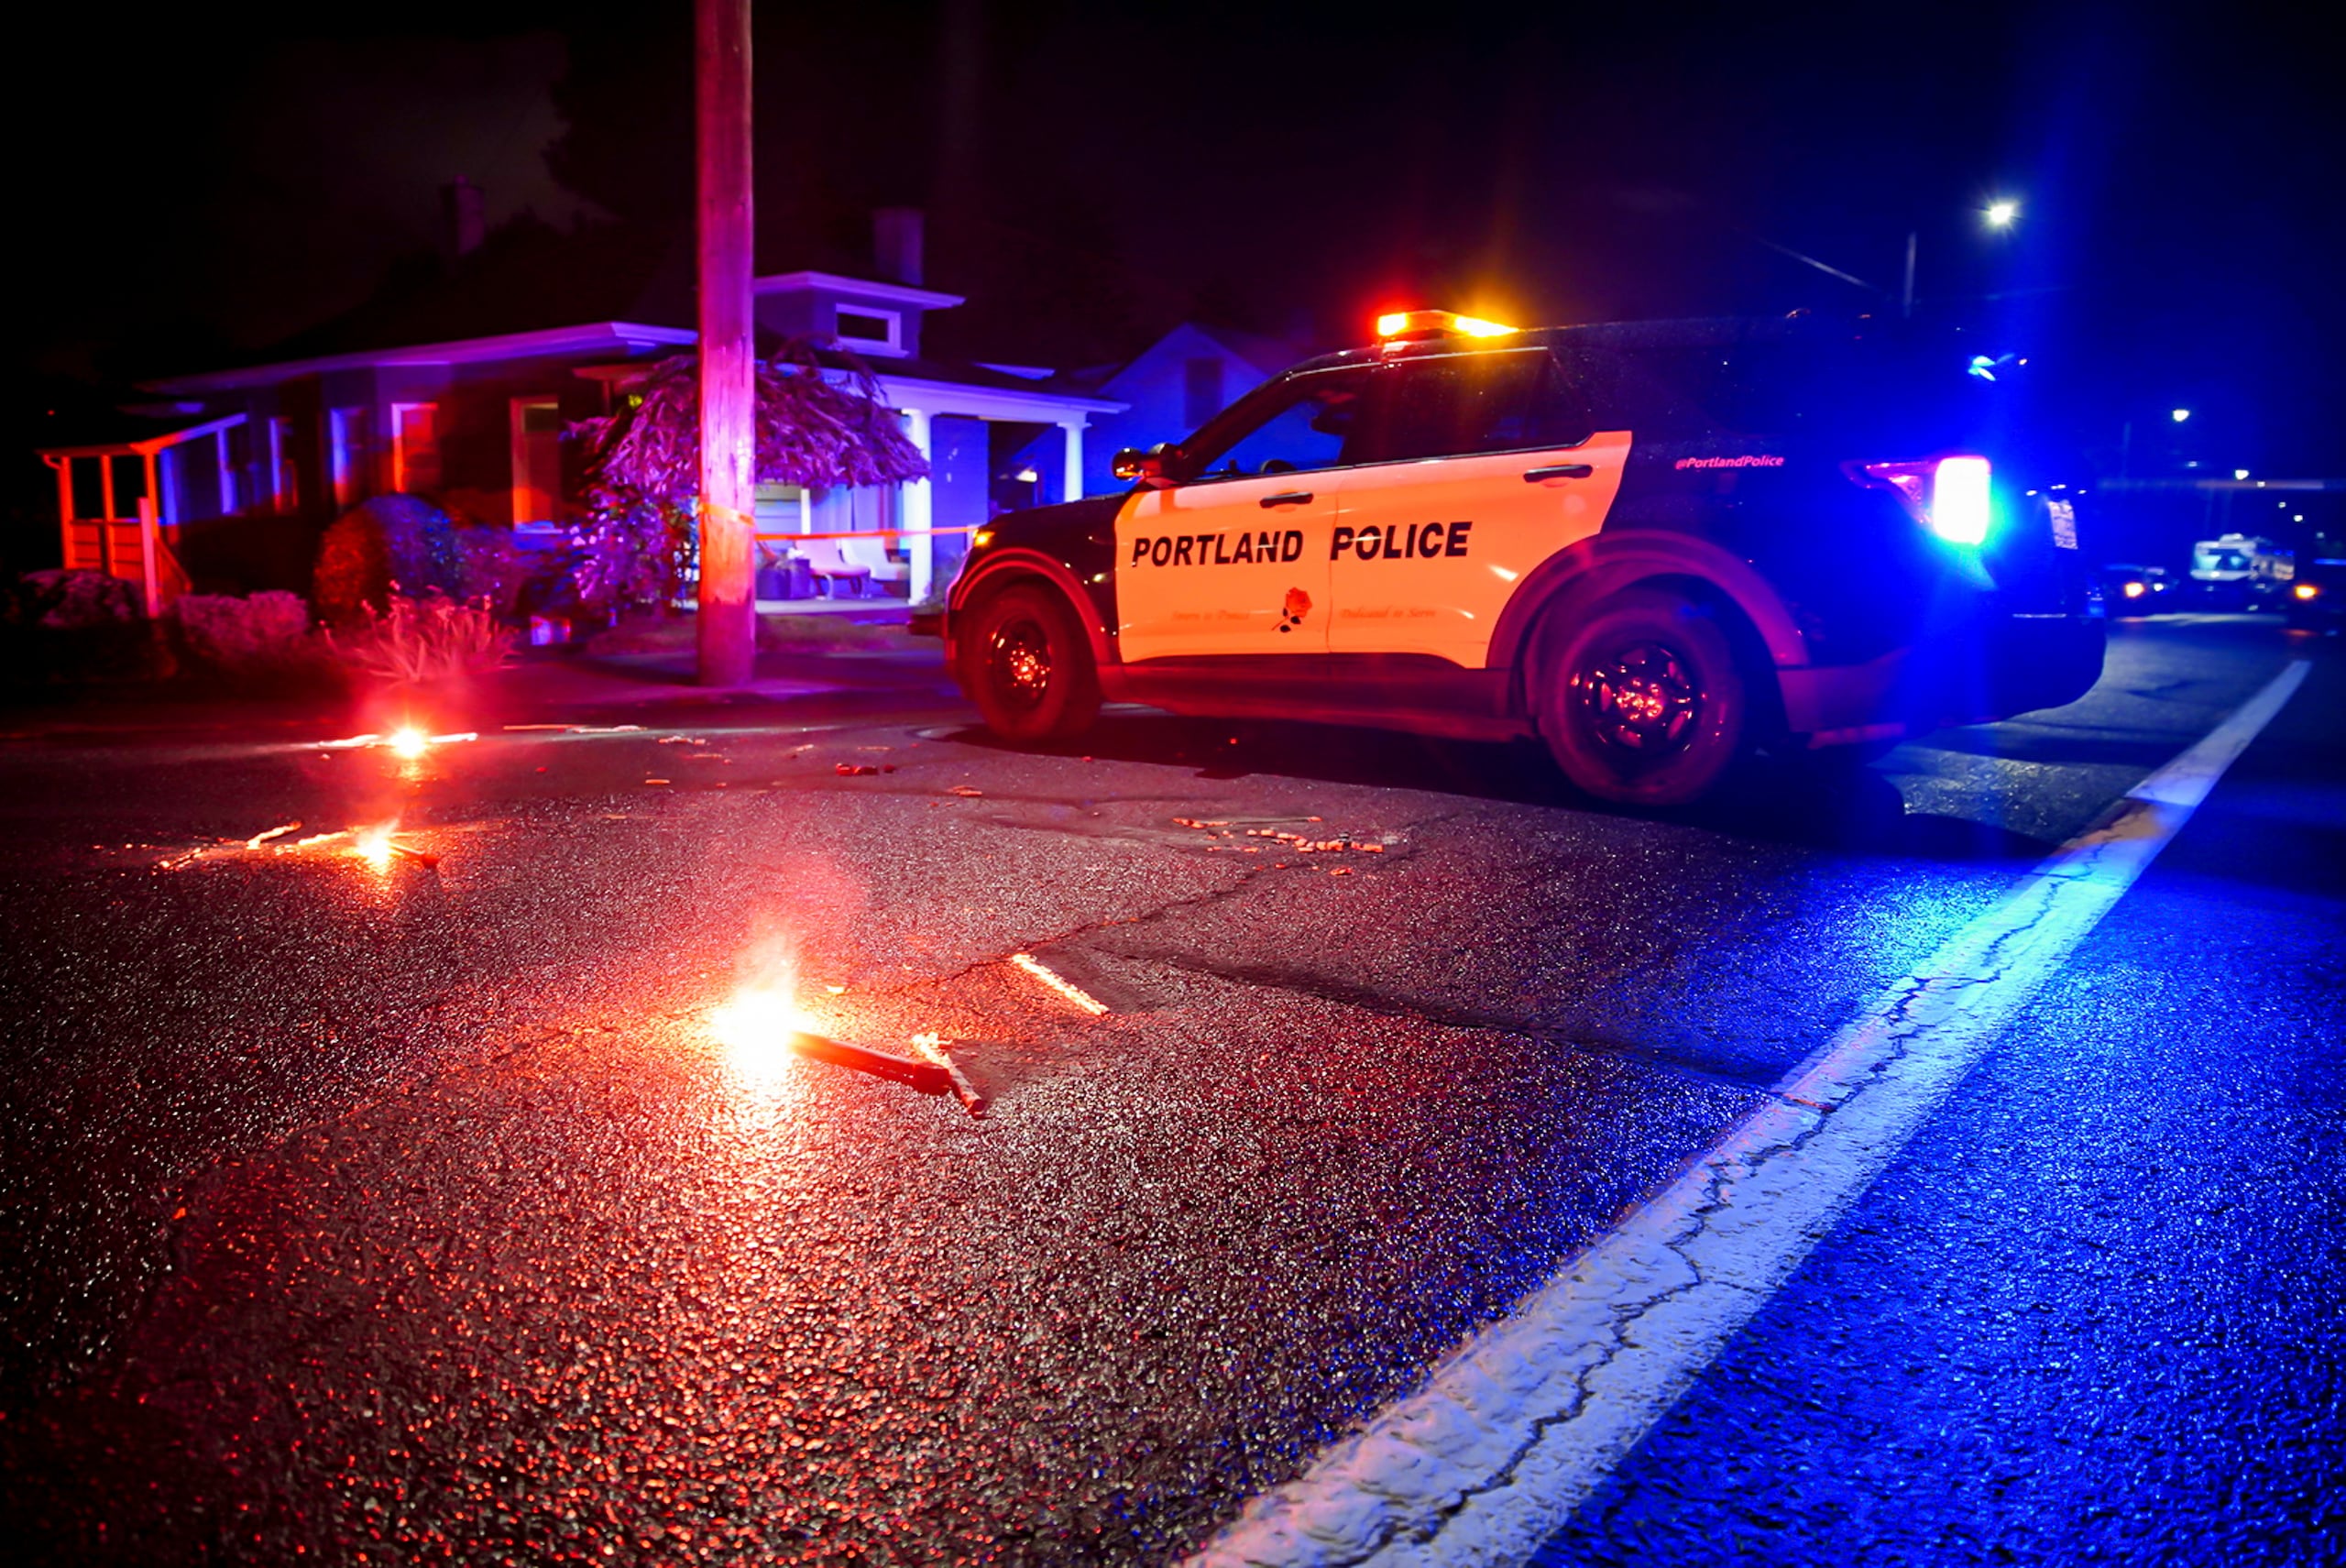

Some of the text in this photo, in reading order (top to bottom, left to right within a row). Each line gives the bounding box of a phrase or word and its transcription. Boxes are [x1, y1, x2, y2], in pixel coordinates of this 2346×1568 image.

[1675, 455, 1783, 469] @PortlandPolice
[1133, 521, 1473, 567] PORTLAND POLICE
